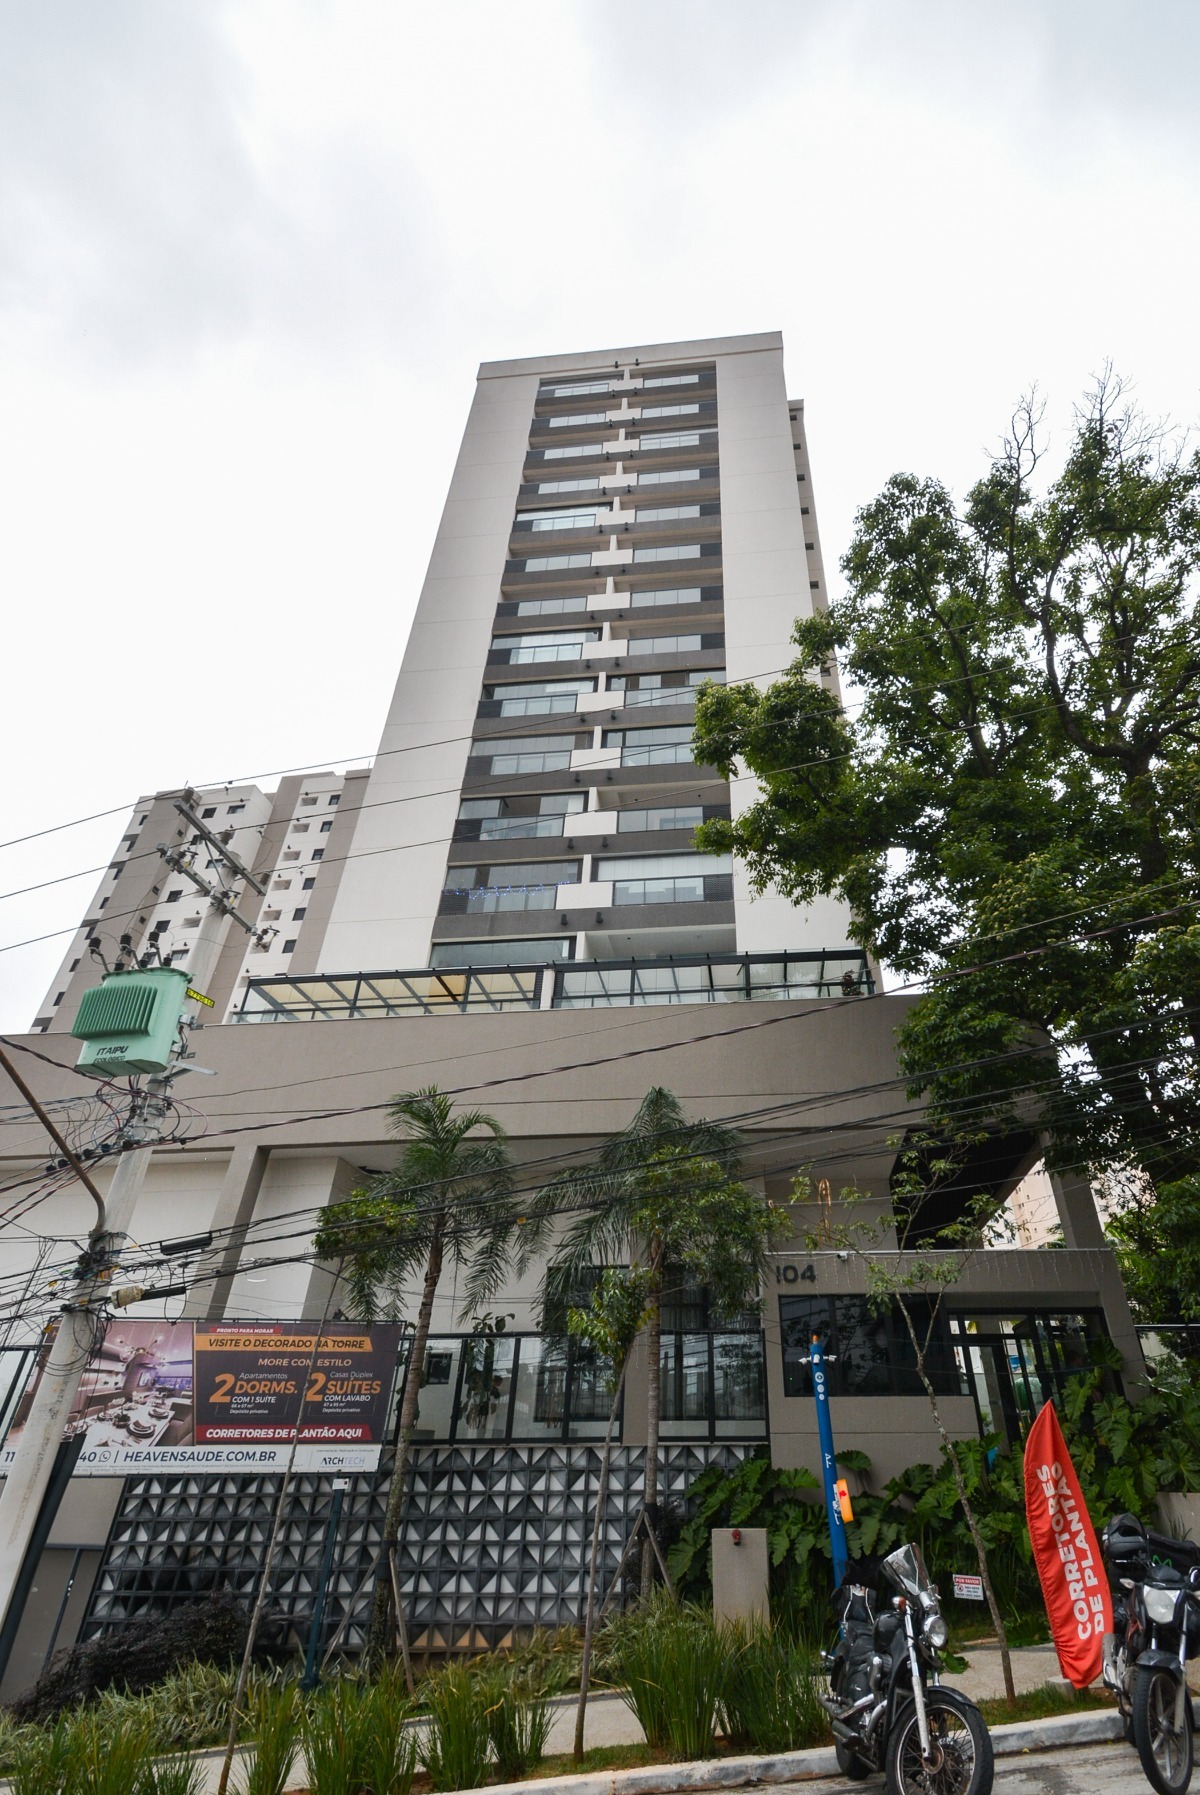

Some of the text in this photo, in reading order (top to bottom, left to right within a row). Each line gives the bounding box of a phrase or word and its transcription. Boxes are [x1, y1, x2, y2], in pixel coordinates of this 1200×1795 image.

[96, 1045, 129, 1056] ITAIPU
[776, 1264, 817, 1283] 104
[209, 1338, 241, 1347] VISITE
[242, 1339, 252, 1347] O
[253, 1339, 312, 1348] DECORADO
[332, 1340, 365, 1348] TORRE
[258, 1358, 289, 1366] MORE
[317, 1359, 352, 1367] ESTILO
[238, 1372, 288, 1380] Apartamentos
[209, 1373, 235, 1403] 2
[234, 1380, 298, 1394] DORMS.
[305, 1372, 326, 1402] 2
[325, 1377, 382, 1394] SUÍTES
[254, 1395, 277, 1403] SUÍTE
[324, 1394, 341, 1402] COM
[206, 1428, 274, 1438] CORRETORES
[275, 1429, 289, 1438] DE
[337, 1428, 362, 1439] AQUI
[124, 1451, 277, 1462] HEAVENSAUDE.COM.BR
[320, 1456, 366, 1466] ARCHTECH
[1036, 1464, 1092, 1640] CORRETORES
[1090, 1593, 1105, 1635] DE
